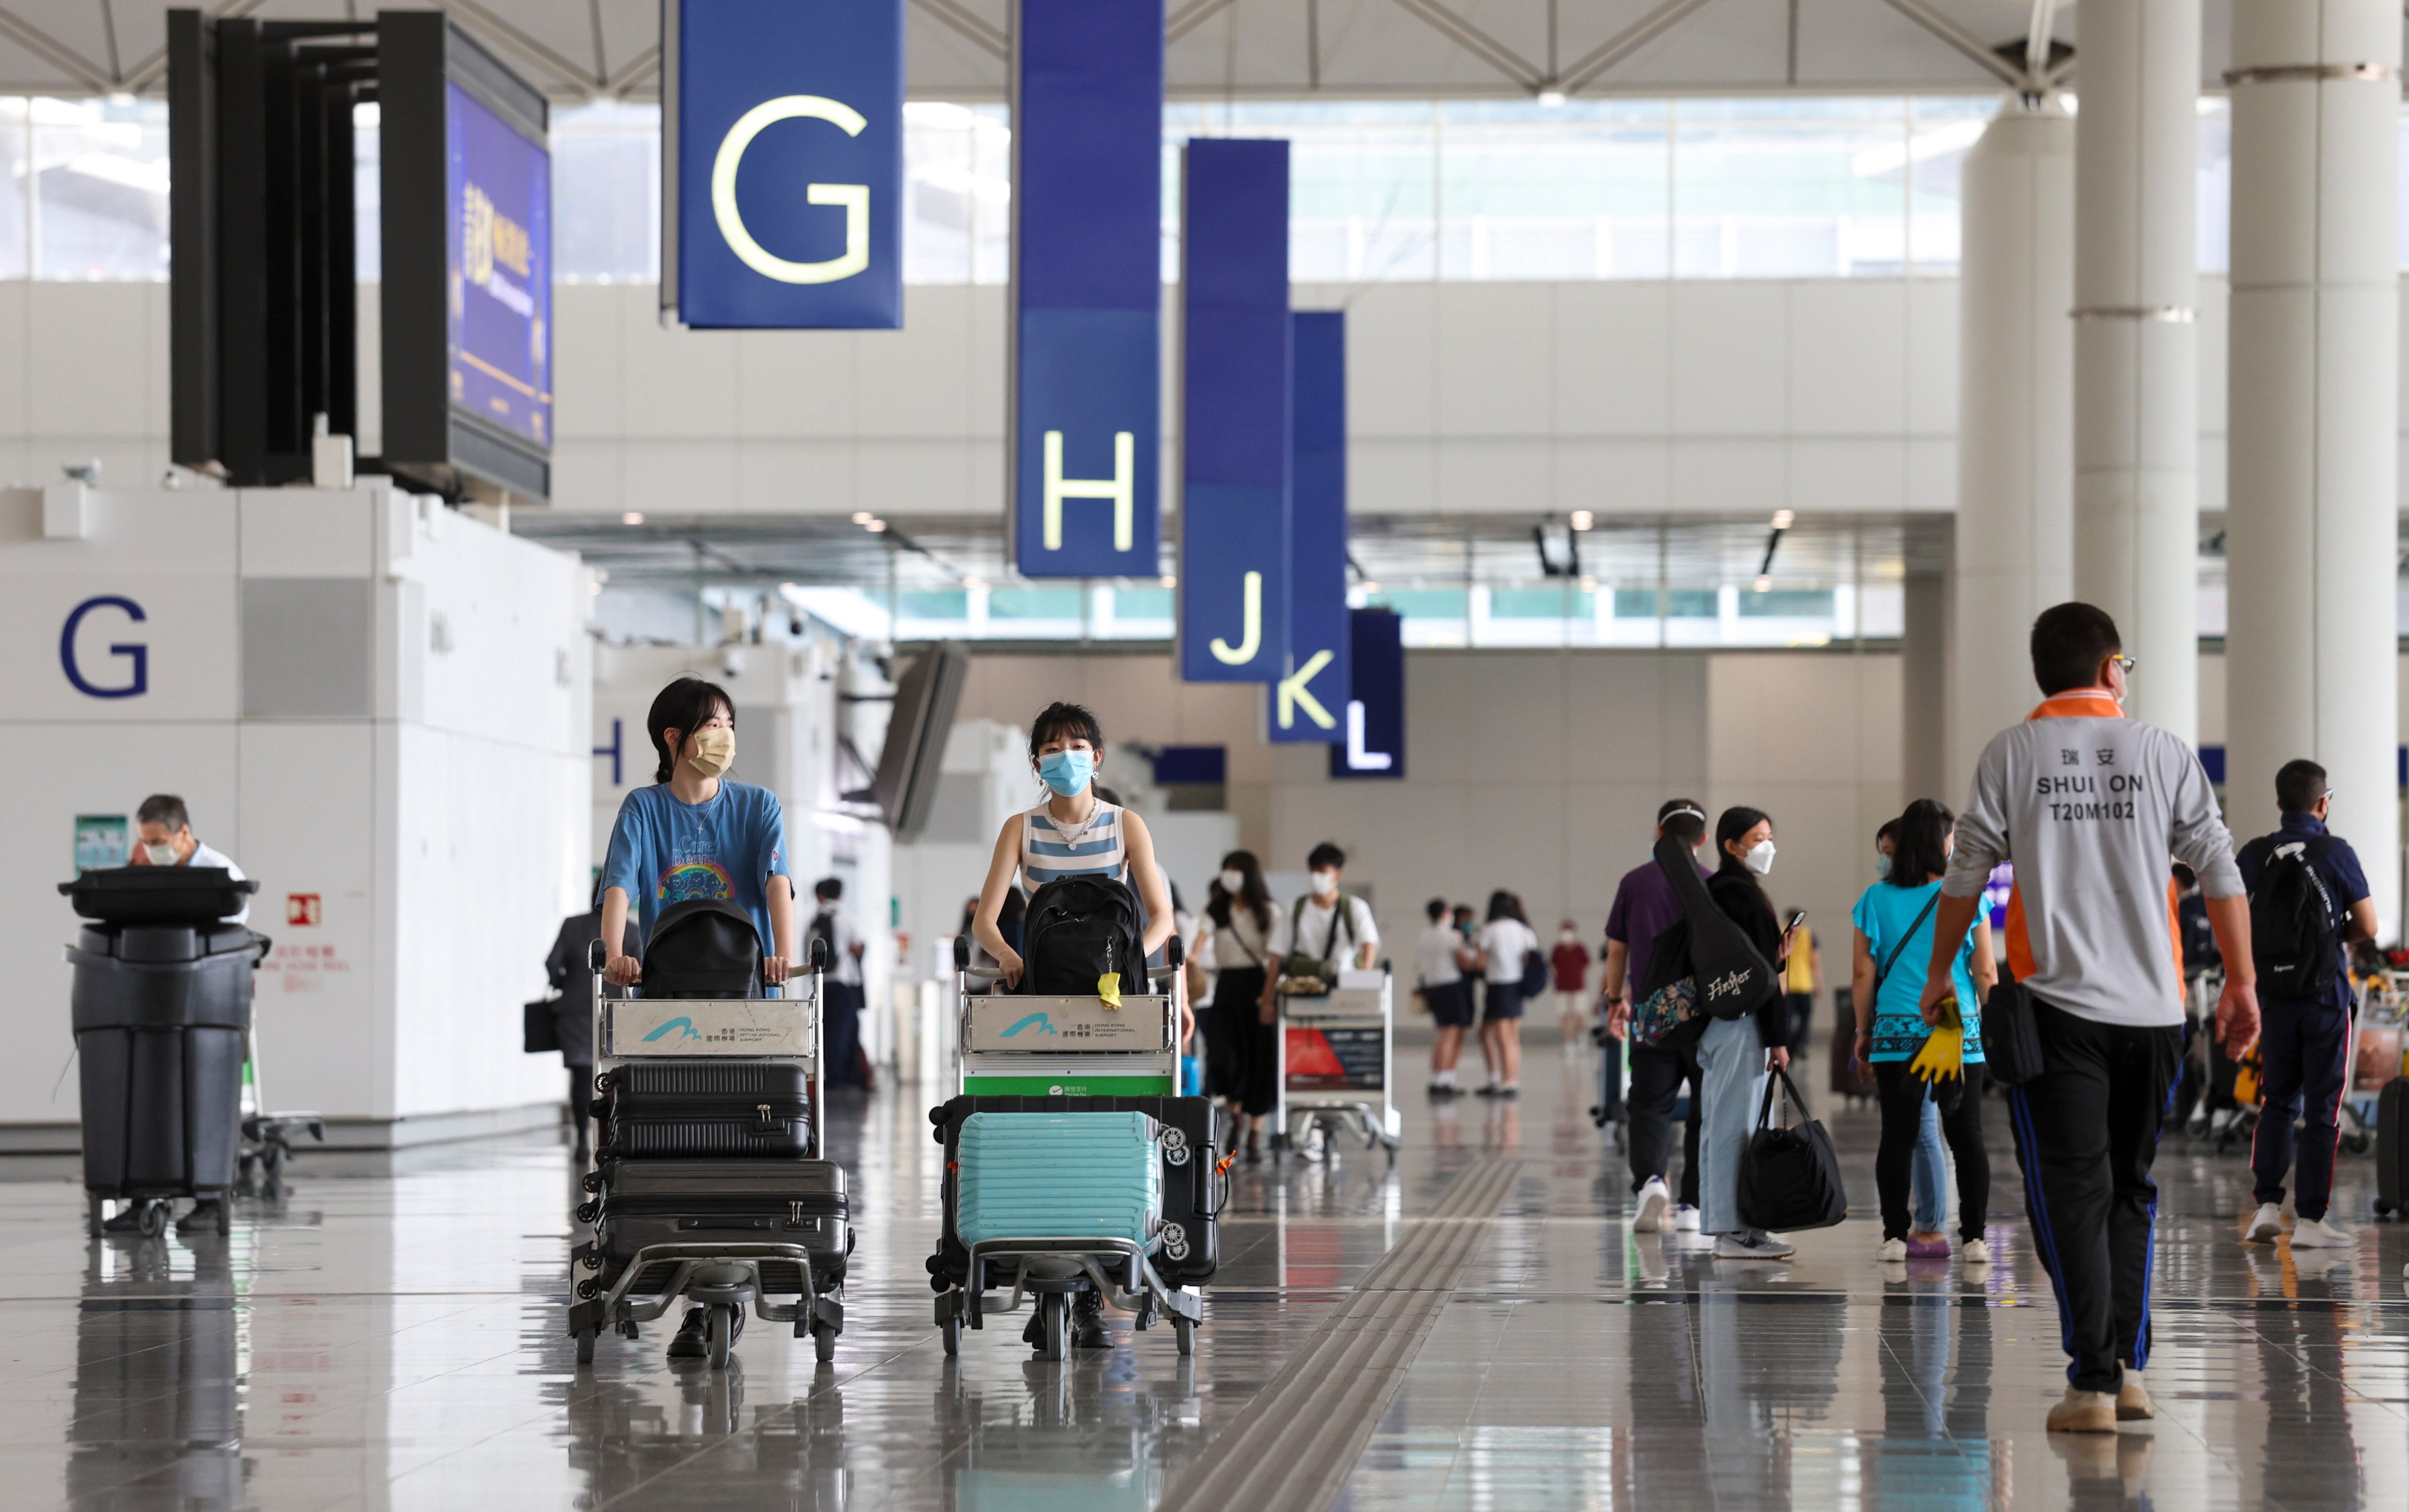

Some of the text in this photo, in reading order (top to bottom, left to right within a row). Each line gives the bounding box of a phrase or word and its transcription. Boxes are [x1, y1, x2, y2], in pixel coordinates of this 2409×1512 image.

[711, 94, 870, 285] G
[1042, 430, 1134, 551] H
[1210, 571, 1262, 666] J
[58, 595, 149, 700] G
[1277, 650, 1337, 731] K
[1347, 700, 1392, 770] L
[2061, 748, 2114, 765] 瑞安
[2037, 775, 2143, 794] SHUI ON
[2050, 801, 2135, 821] T20M102
[672, 848, 718, 867] Bears
[678, 835, 714, 853] Care
[1708, 967, 1753, 1001] Finger
